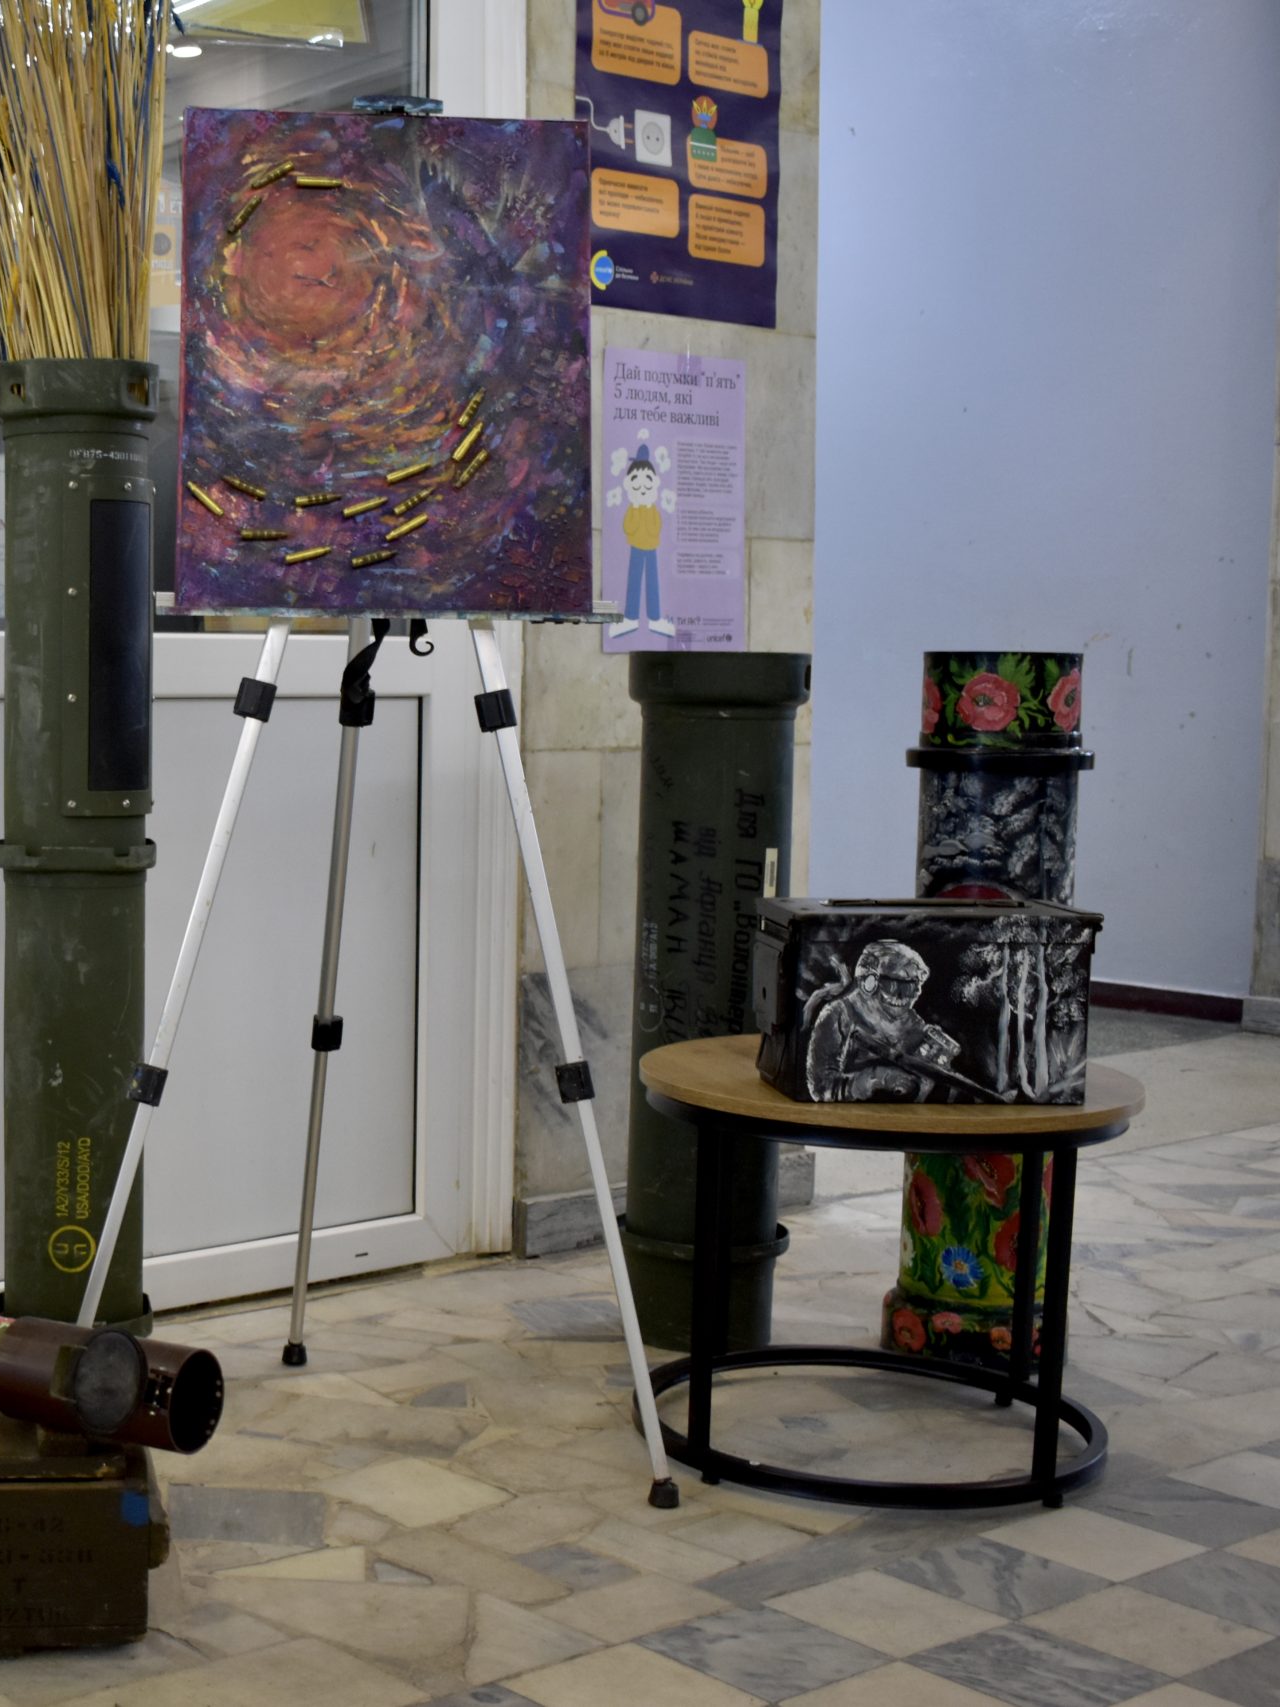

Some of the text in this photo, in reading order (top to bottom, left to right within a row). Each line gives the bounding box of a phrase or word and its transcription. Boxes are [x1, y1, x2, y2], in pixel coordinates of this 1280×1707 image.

[614, 362, 641, 382] Дай
[644, 370, 698, 388] подумки
[614, 383, 692, 406] 5 людям, які
[614, 406, 720, 428] для тебе важливі
[734, 788, 766, 840] Для
[693, 826, 722, 860] від
[666, 820, 692, 956] ШАМАН
[735, 858, 763, 894] ГО
[56, 1141, 70, 1217] 1A2/Y33/S/12
[76, 1137, 91, 1220] USA/DOD/AYD
[12, 1577, 27, 1594] T
